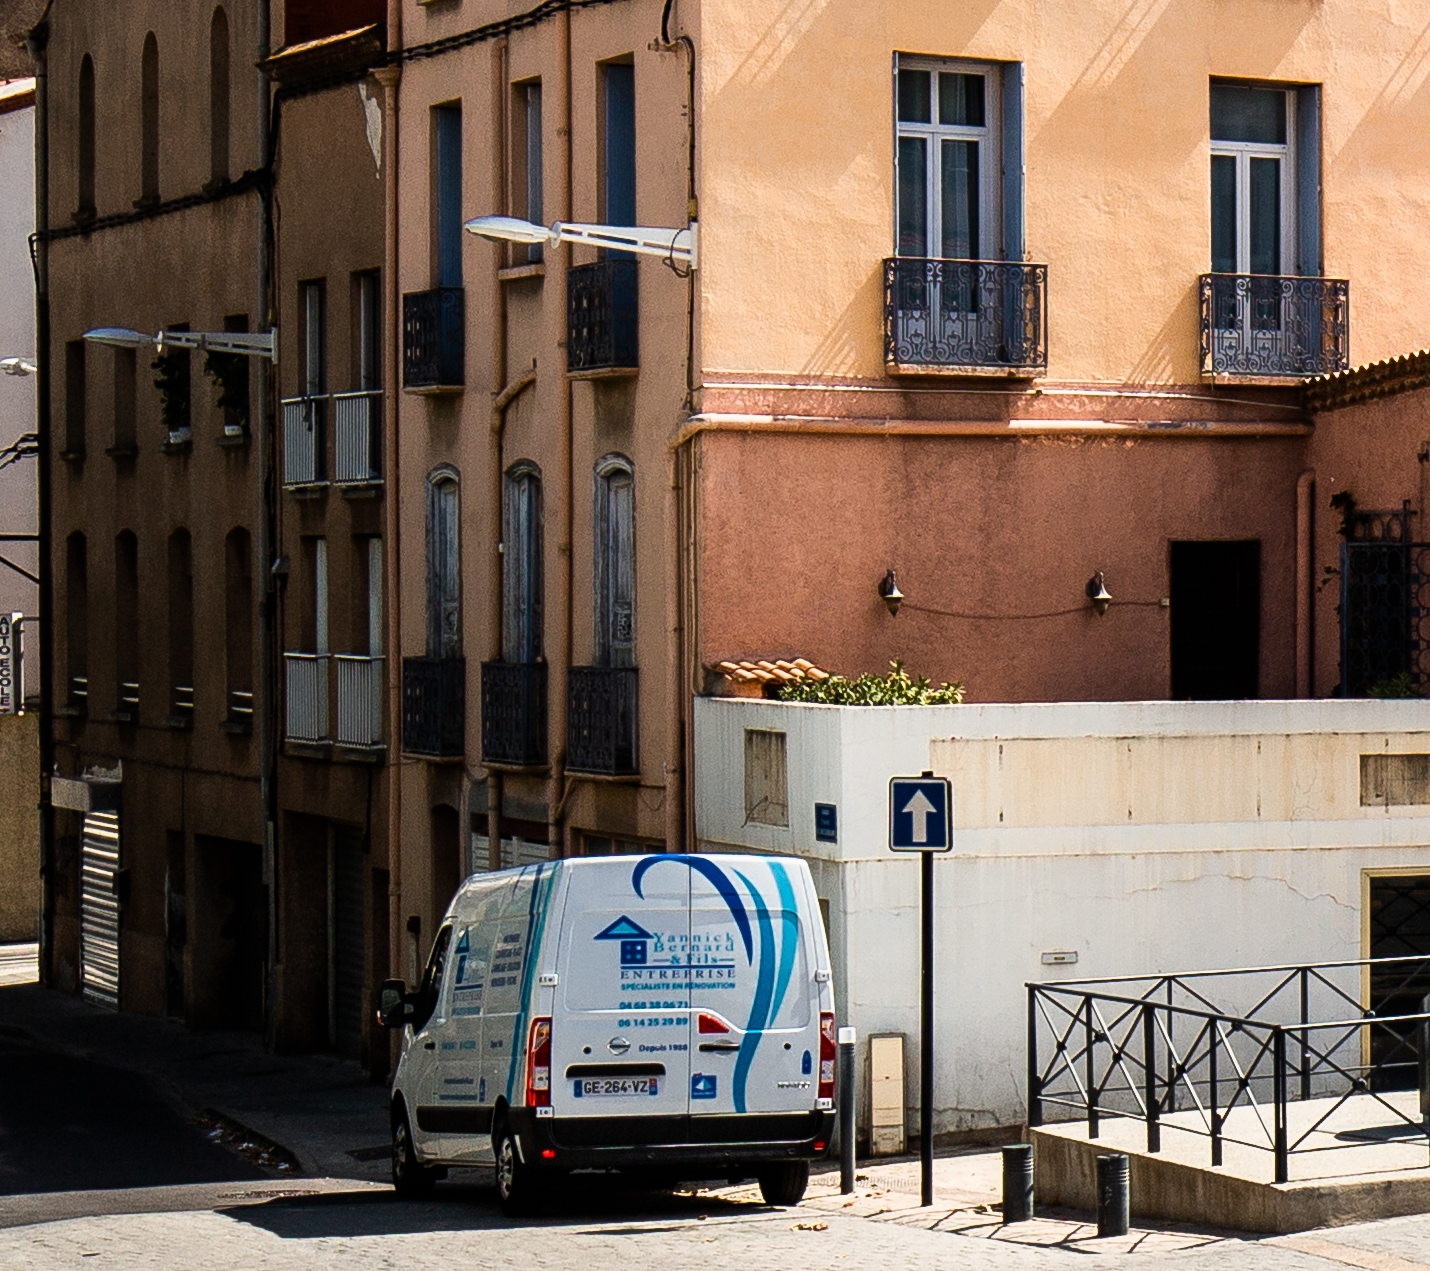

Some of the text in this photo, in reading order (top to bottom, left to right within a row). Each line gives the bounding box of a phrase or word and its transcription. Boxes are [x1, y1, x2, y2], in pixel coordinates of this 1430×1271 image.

[0, 617, 11, 707] AUTO ECOLE
[653, 932, 735, 943] Yannick
[654, 941, 734, 952] Bernard
[670, 955, 680, 965] &
[620, 969, 736, 979] ENTREPRISE
[639, 1044, 667, 1053] Depuis
[583, 1080, 649, 1094] GE-264-VZ
